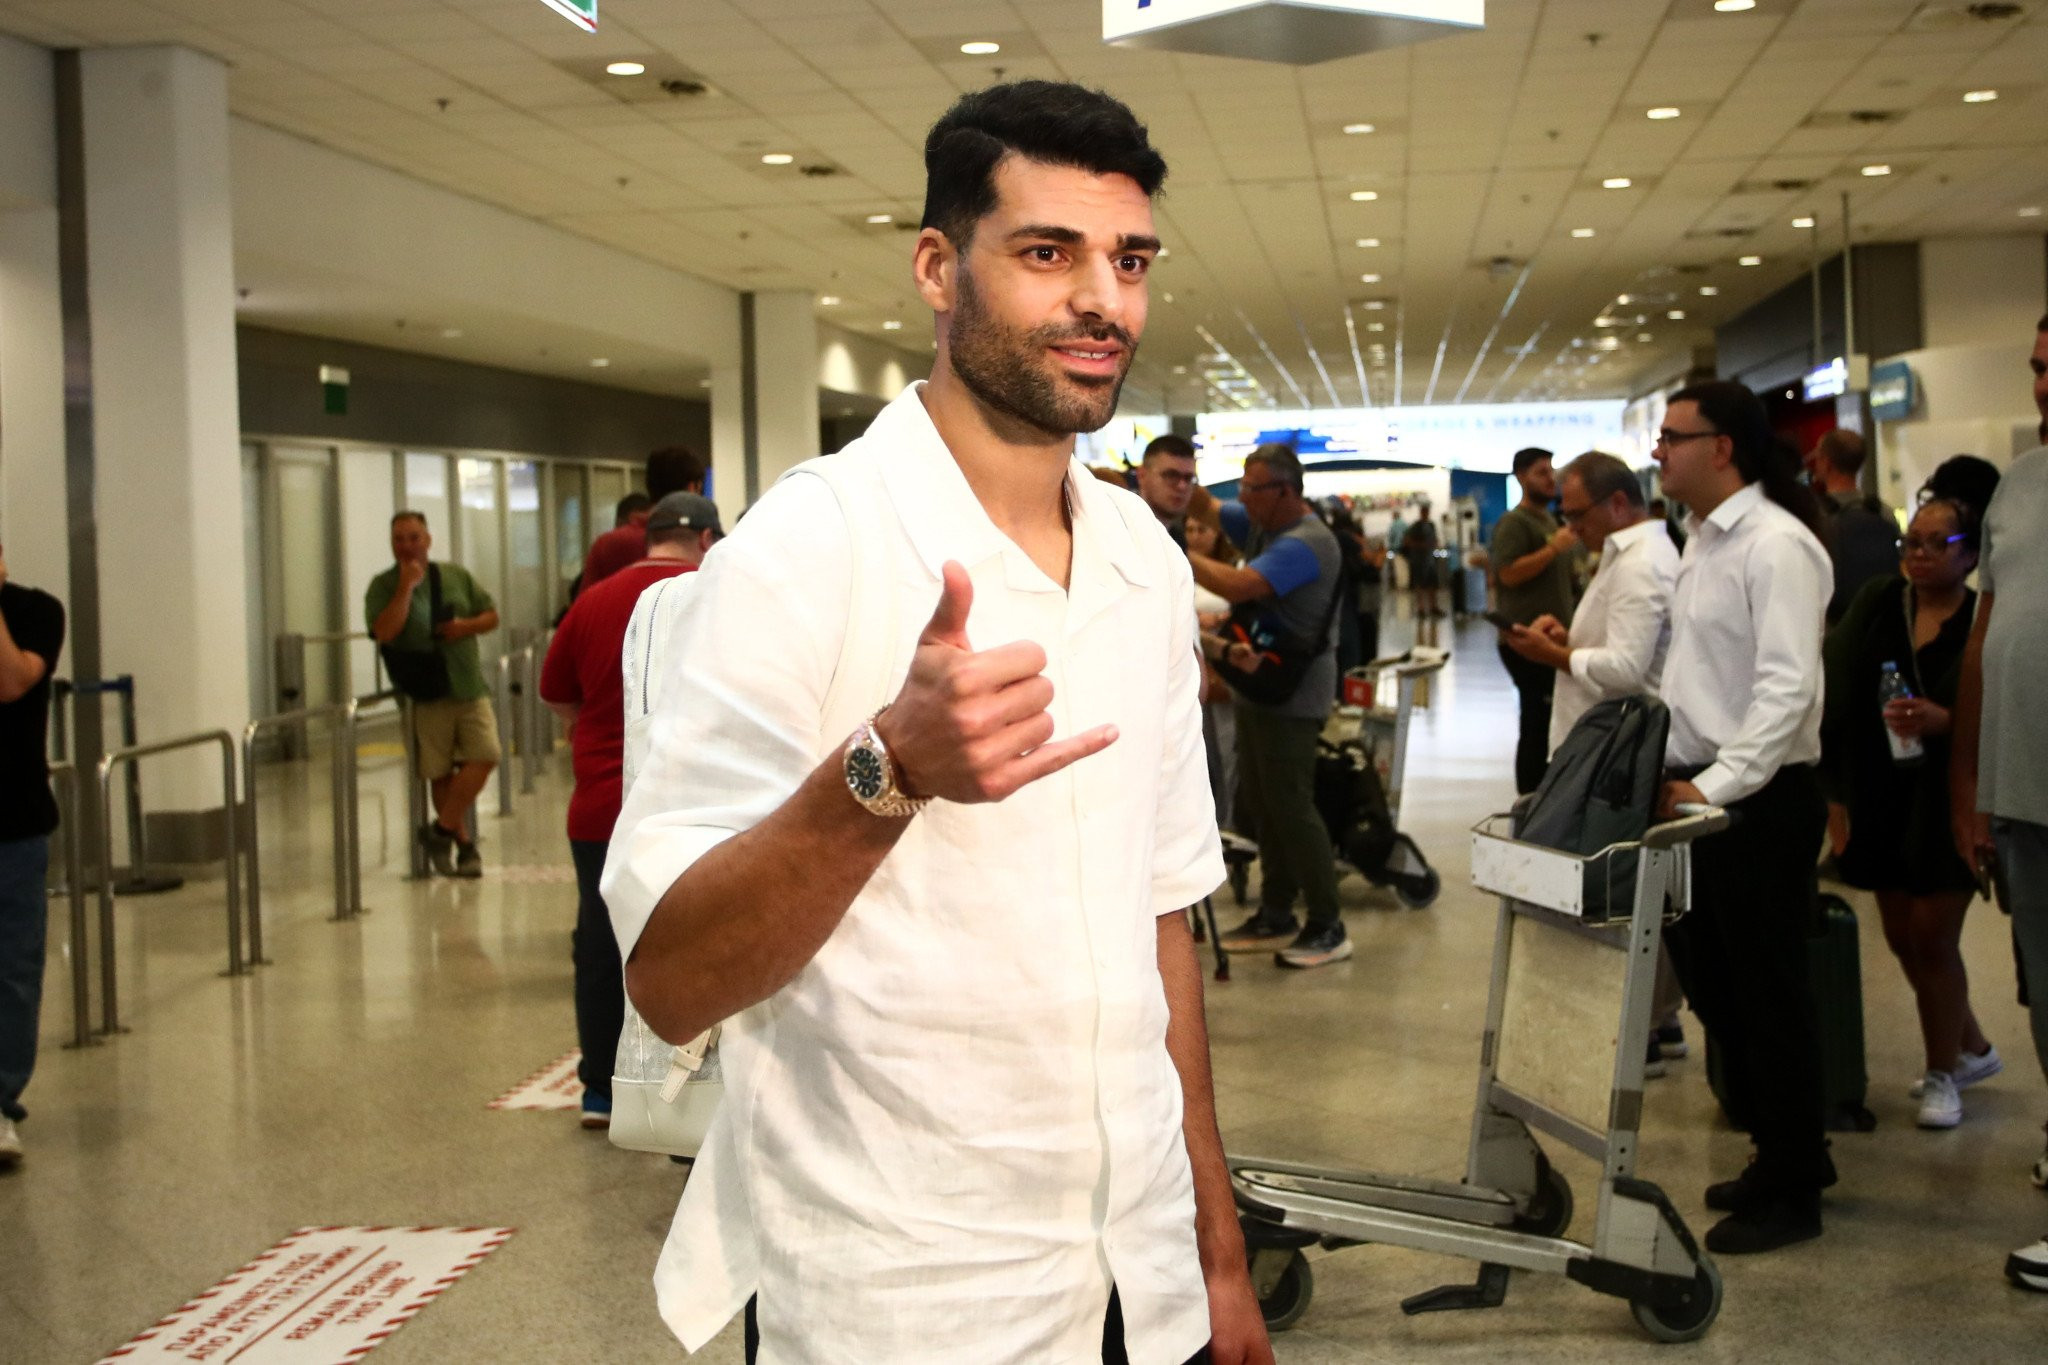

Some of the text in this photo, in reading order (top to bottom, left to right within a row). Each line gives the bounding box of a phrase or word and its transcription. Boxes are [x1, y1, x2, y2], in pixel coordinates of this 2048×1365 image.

[1493, 412, 1595, 428] WRAPPING
[283, 1260, 403, 1339] REMAIN BEHIND
[336, 1276, 415, 1325] THIS LINE
[186, 1335, 233, 1360] ΑΠΟ
